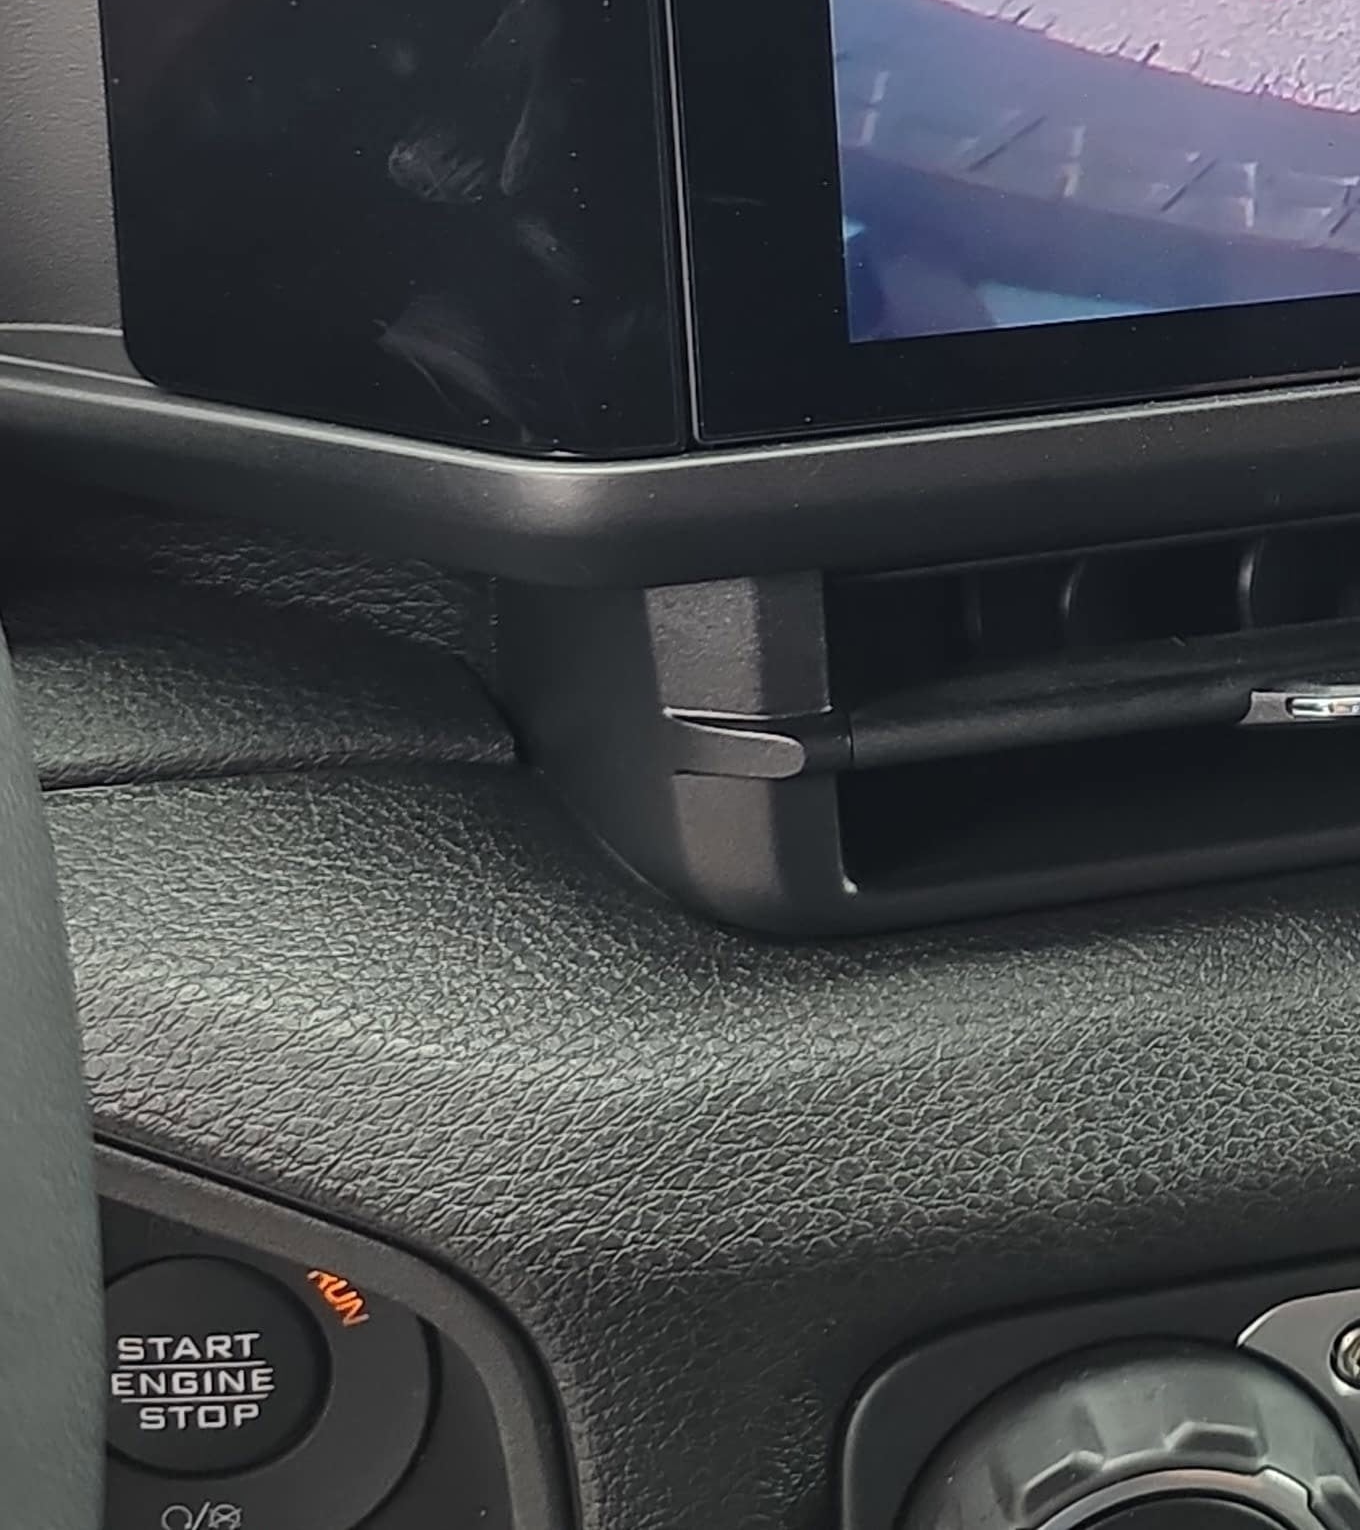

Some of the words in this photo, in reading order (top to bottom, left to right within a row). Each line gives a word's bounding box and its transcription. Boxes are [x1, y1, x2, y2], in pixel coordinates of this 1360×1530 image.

[306, 1270, 370, 1327] RUN
[116, 1333, 260, 1362] START
[110, 1367, 276, 1396] ENGINE
[139, 1402, 261, 1430] STOP
